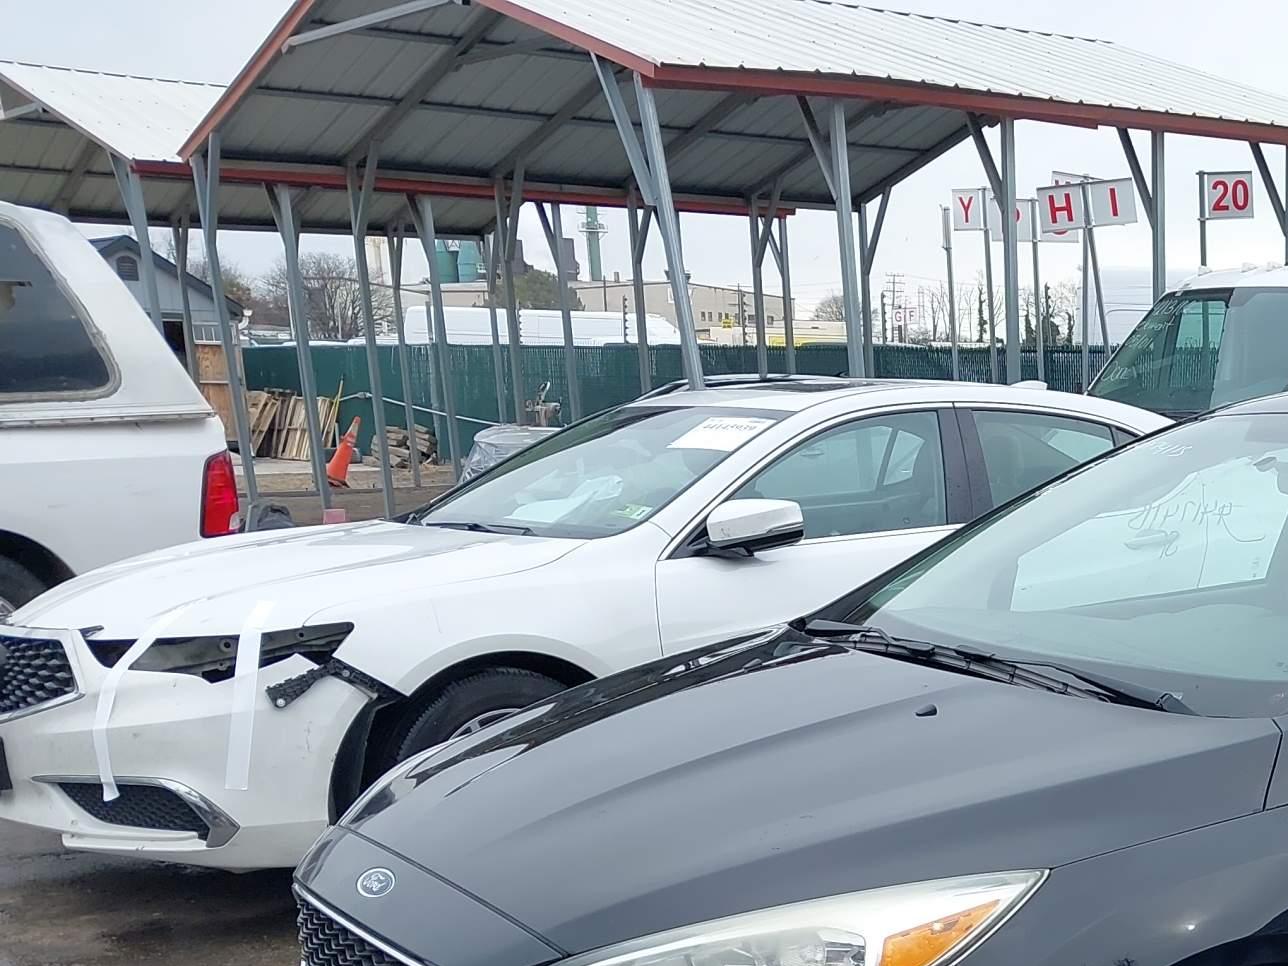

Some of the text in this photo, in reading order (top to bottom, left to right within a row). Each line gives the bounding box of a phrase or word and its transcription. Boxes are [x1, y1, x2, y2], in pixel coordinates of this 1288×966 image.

[958, 195, 974, 224] Y
[1048, 193, 1074, 224] H
[1109, 187, 1119, 217] I
[1211, 179, 1249, 212] 20
